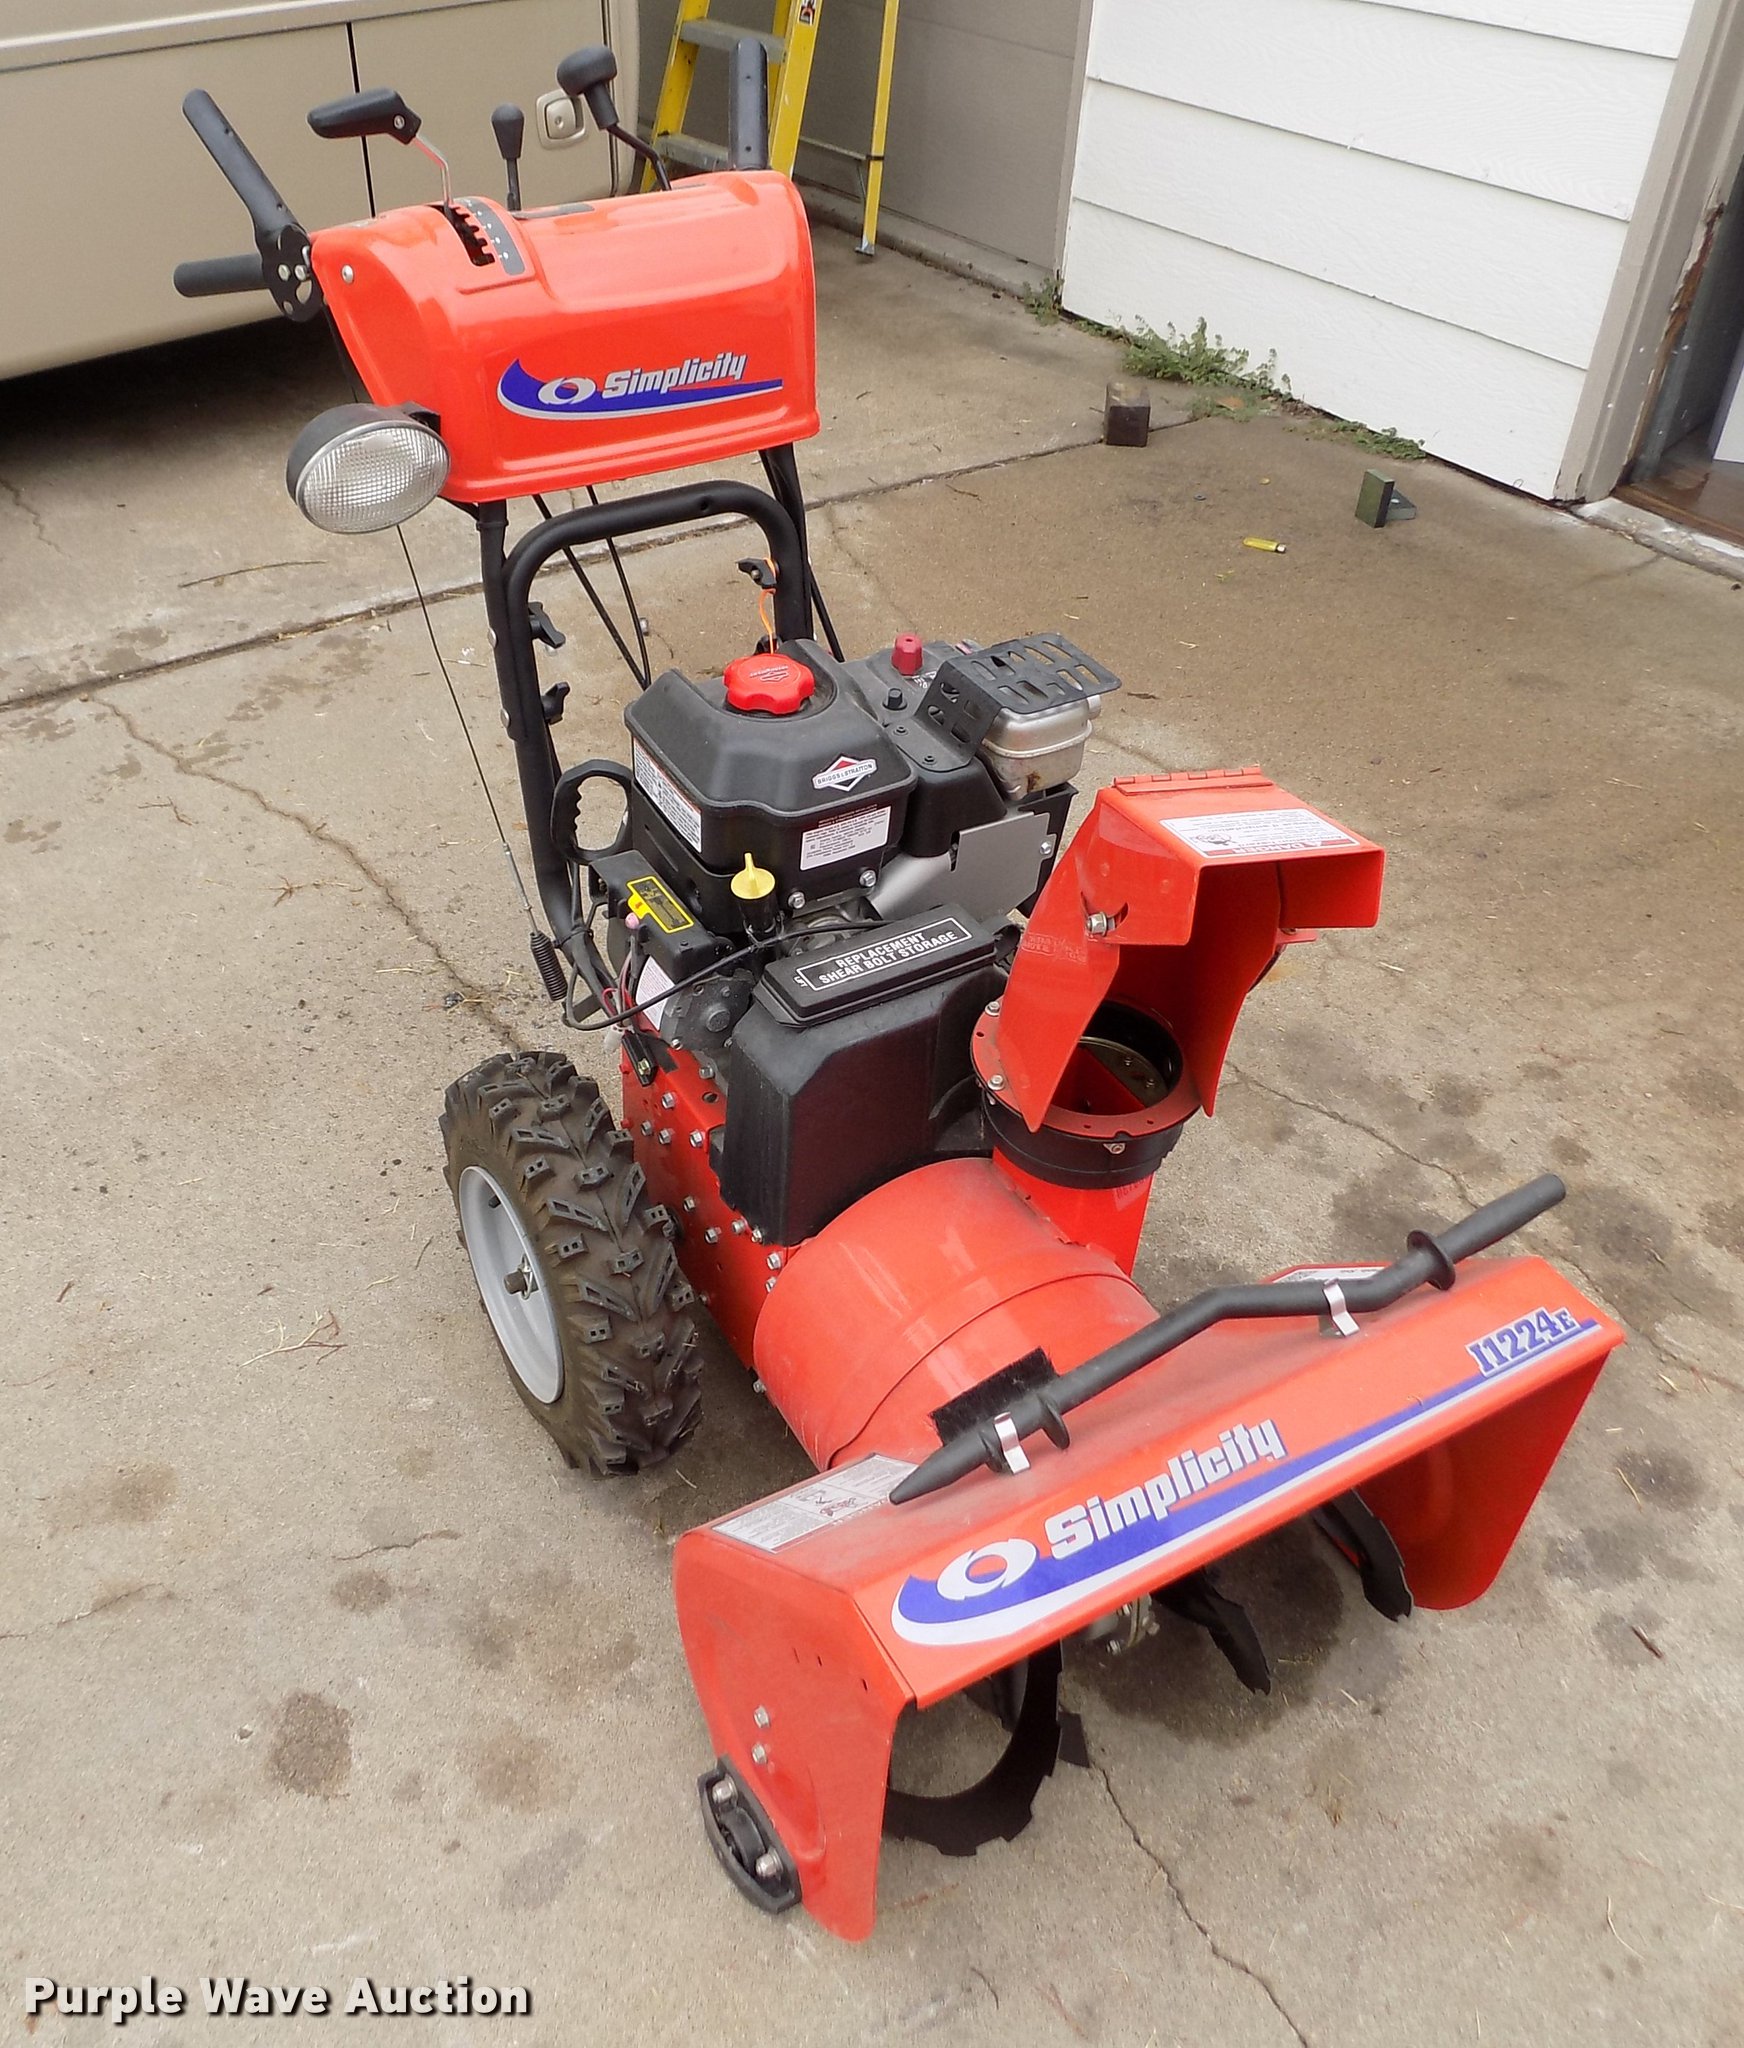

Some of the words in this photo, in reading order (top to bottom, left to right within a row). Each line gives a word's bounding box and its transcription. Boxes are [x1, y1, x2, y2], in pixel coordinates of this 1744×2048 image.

[601, 352, 747, 399] Simplicity
[818, 963, 864, 984] SHEAR
[865, 951, 898, 970] BOLT
[899, 931, 958, 958] STORAGE
[835, 932, 926, 969] REPLACEMENT
[1044, 1418, 1287, 1561] Simplicity
